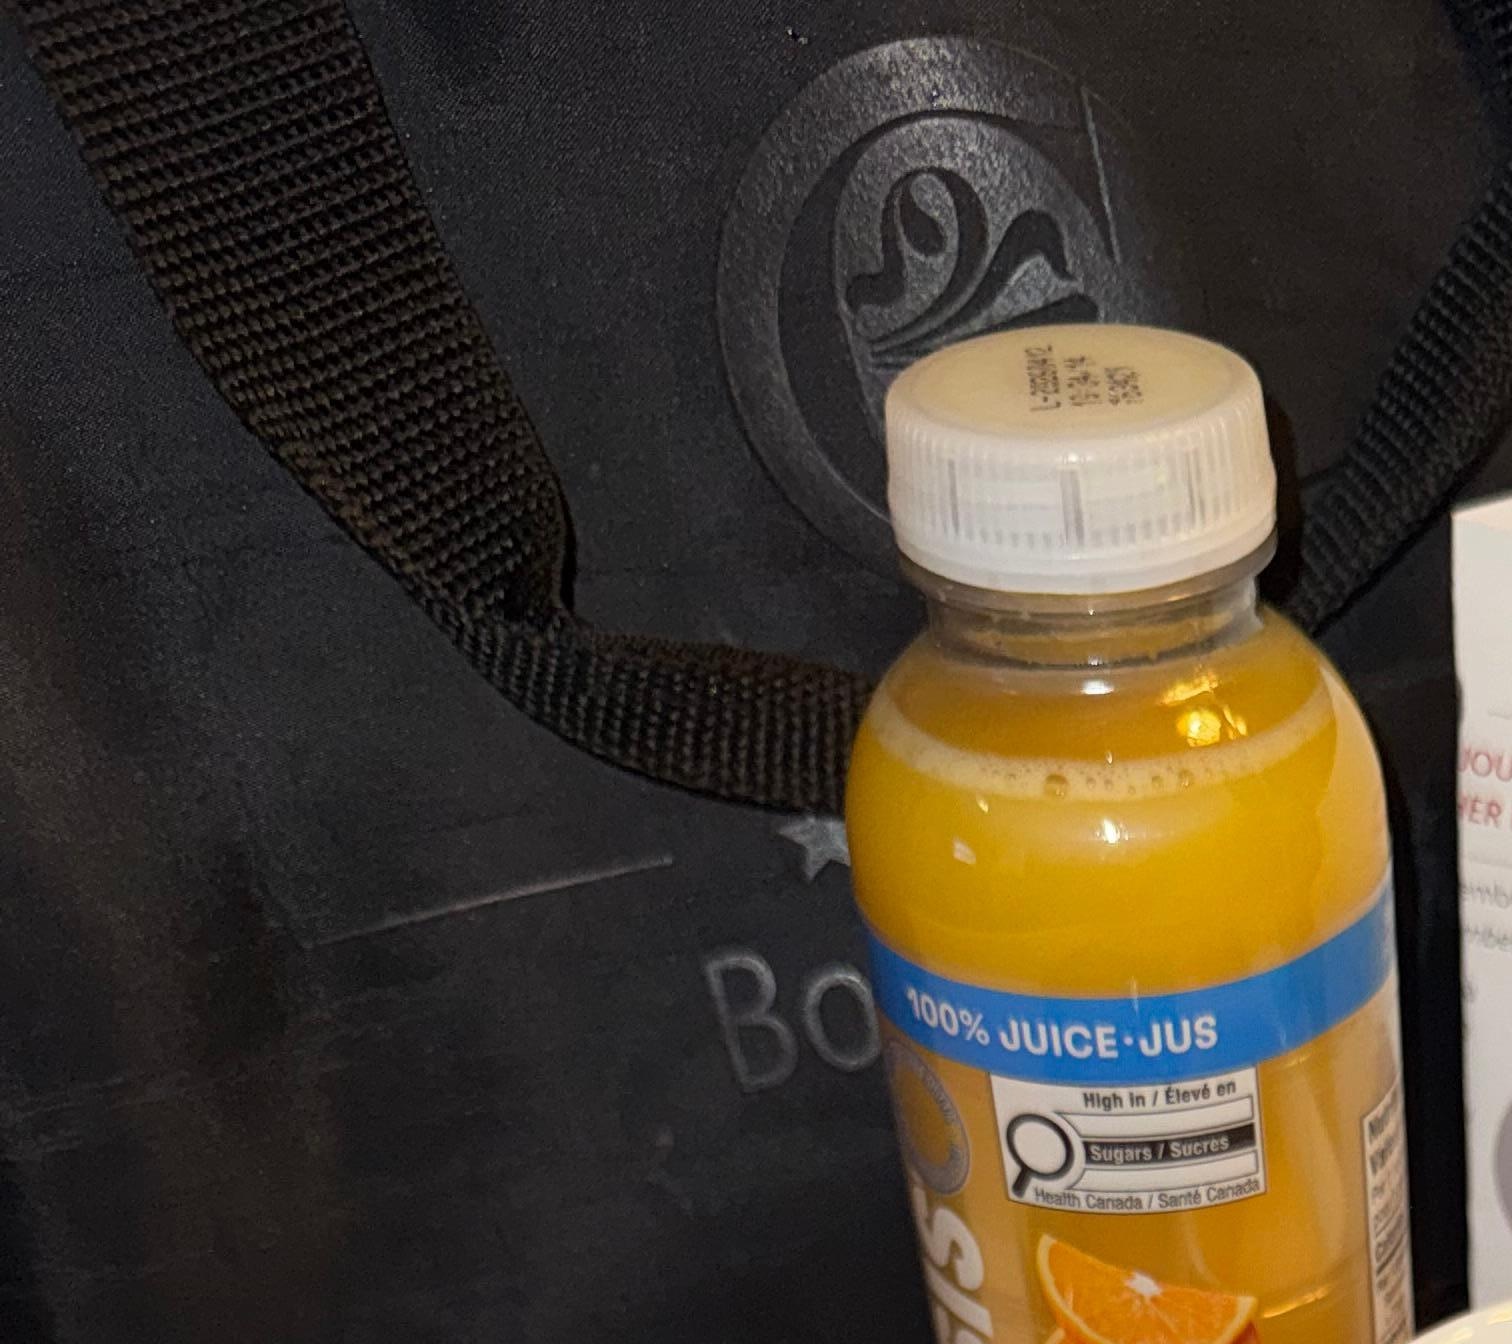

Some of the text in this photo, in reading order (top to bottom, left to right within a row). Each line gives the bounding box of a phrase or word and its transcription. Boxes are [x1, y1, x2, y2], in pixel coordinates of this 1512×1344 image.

[905, 987, 990, 1046] 100%
[1082, 1091, 1126, 1112] High
[1129, 1091, 1146, 1108] in
[1164, 1082, 1210, 1106] Élevé
[1217, 1081, 1236, 1097] en
[1089, 1144, 1152, 1166] Sugars
[1170, 1136, 1230, 1159] Sucres
[1033, 1187, 1081, 1209] Health
[1085, 1192, 1143, 1211] Canada
[1157, 1187, 1201, 1208] Santé
[1206, 1178, 1261, 1203] Canada
